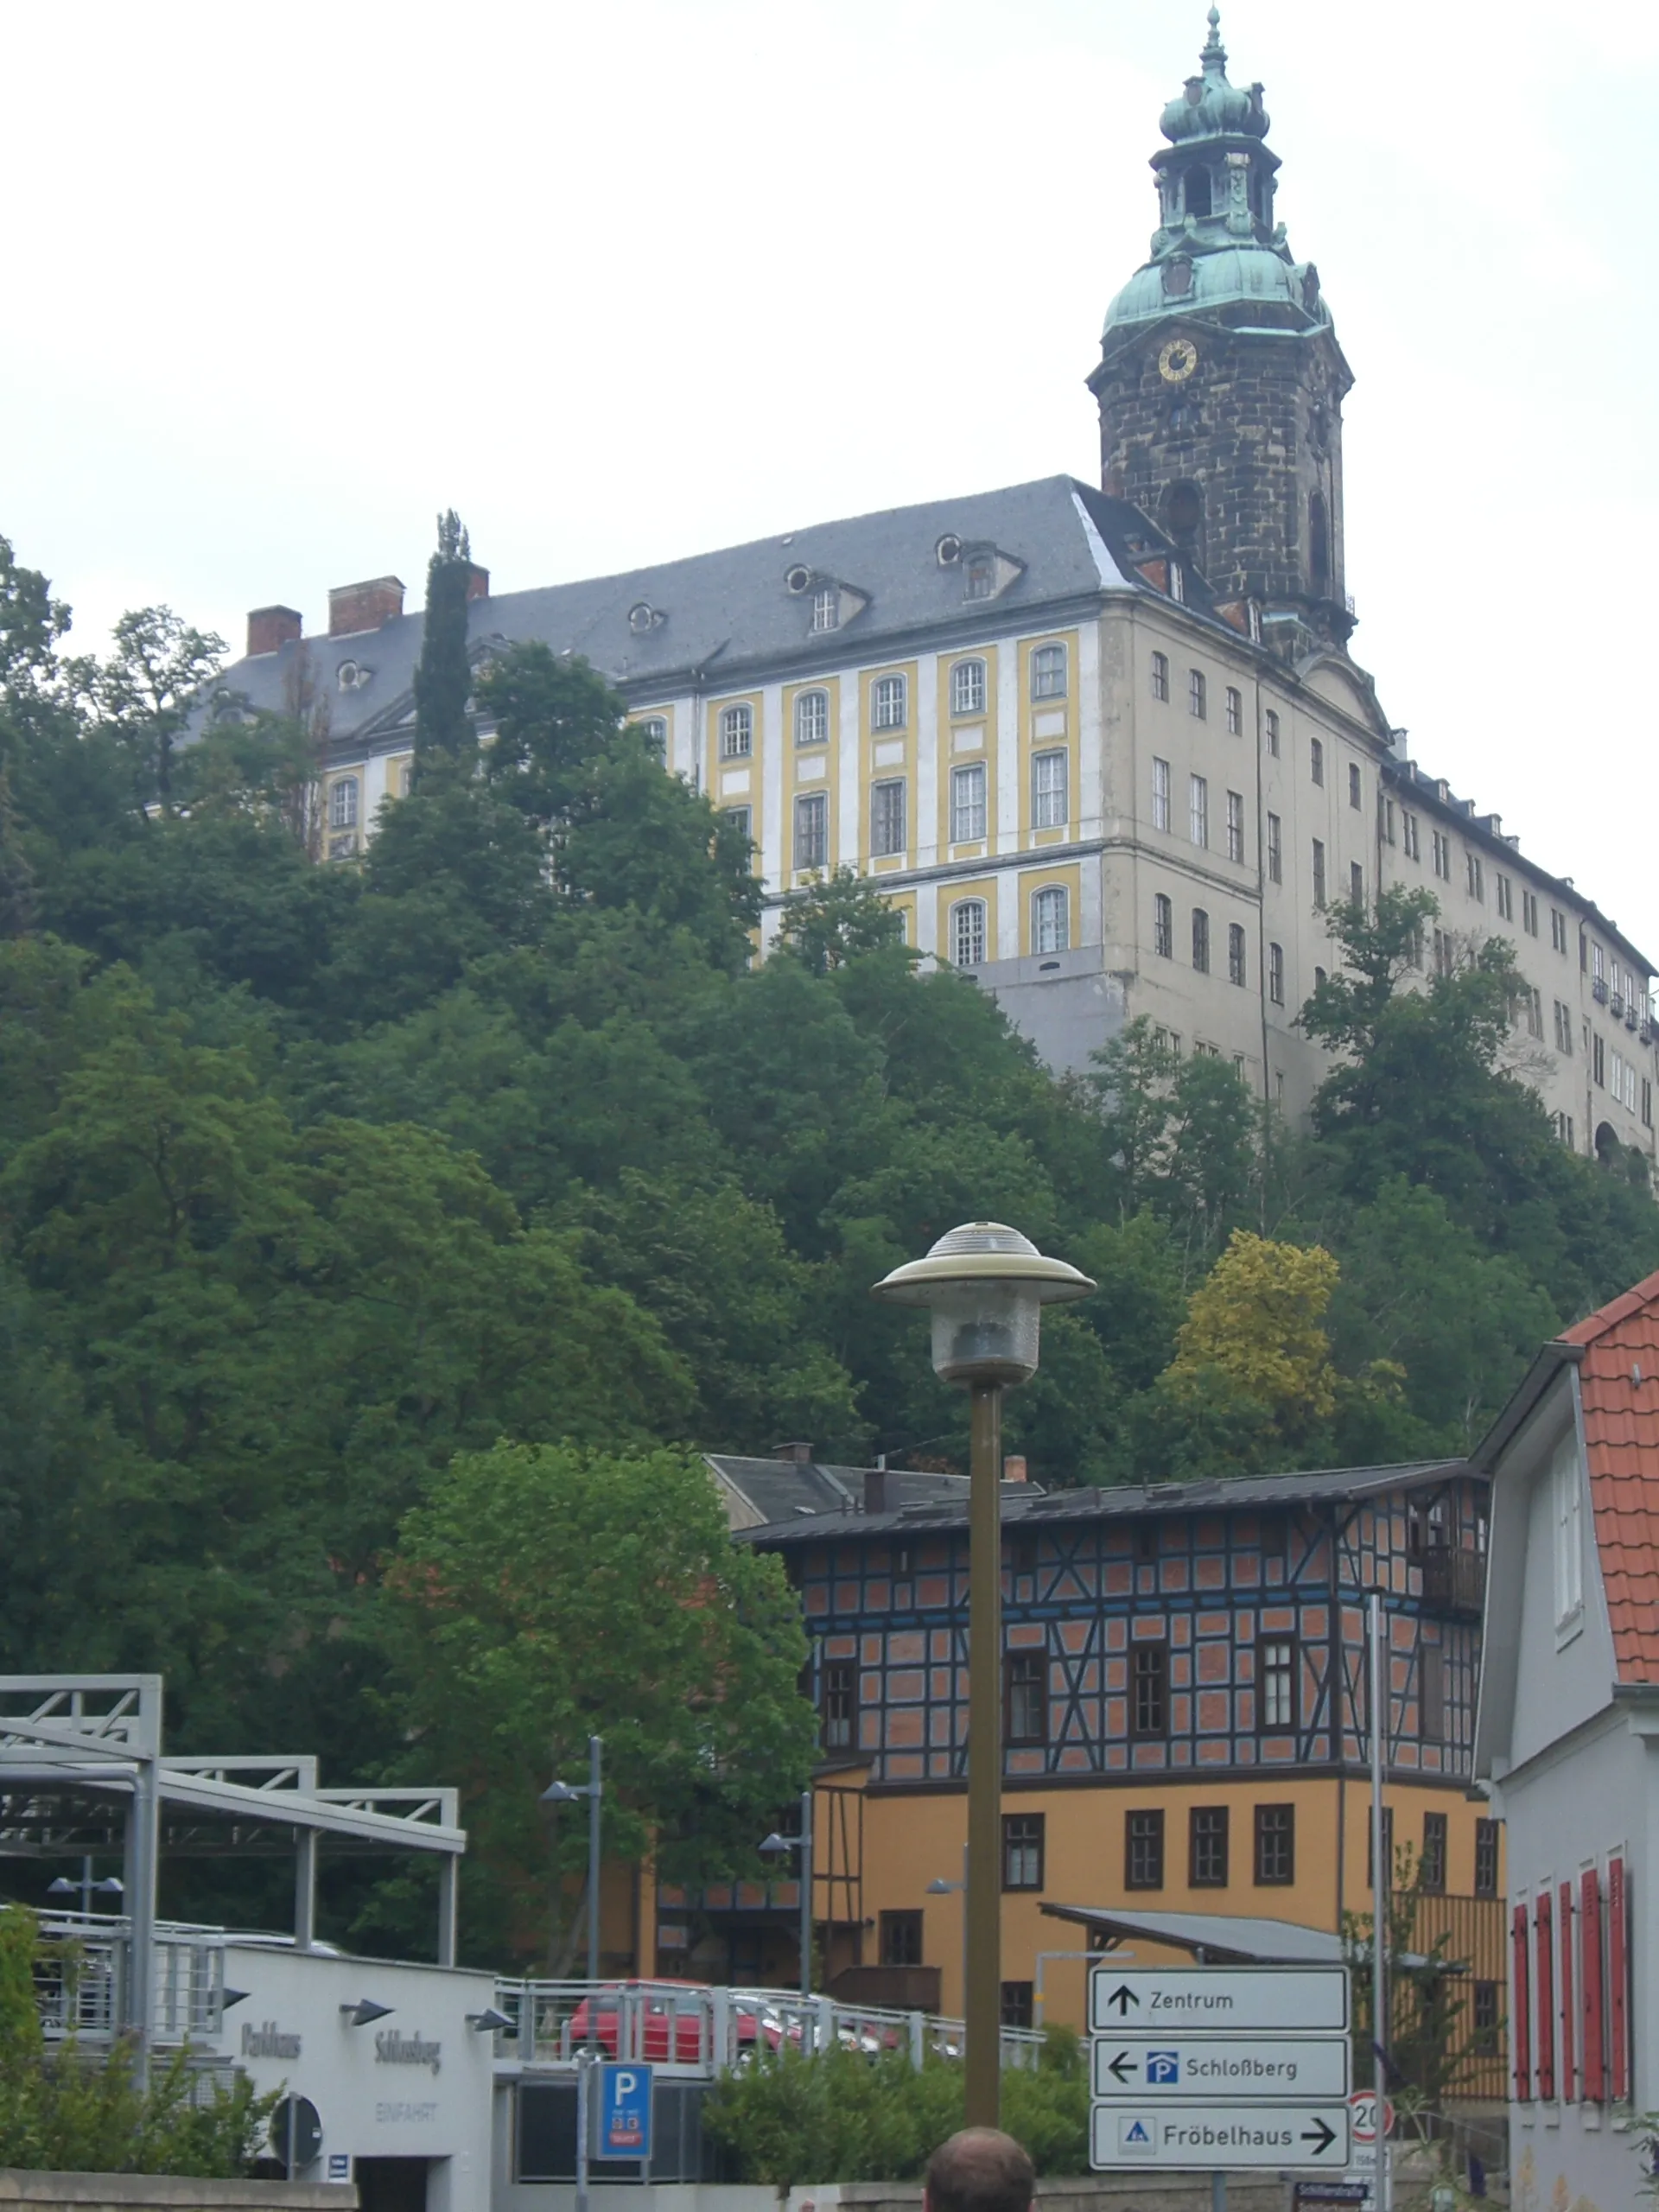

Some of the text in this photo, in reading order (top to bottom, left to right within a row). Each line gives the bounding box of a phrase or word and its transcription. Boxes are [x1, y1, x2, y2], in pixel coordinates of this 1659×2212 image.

[1150, 1991, 1234, 2009] Zentrum
[1186, 2059, 1298, 2081] Schloßberg
[615, 2072, 636, 2106] P
[1163, 2126, 1293, 2145] Fröbelhaus
